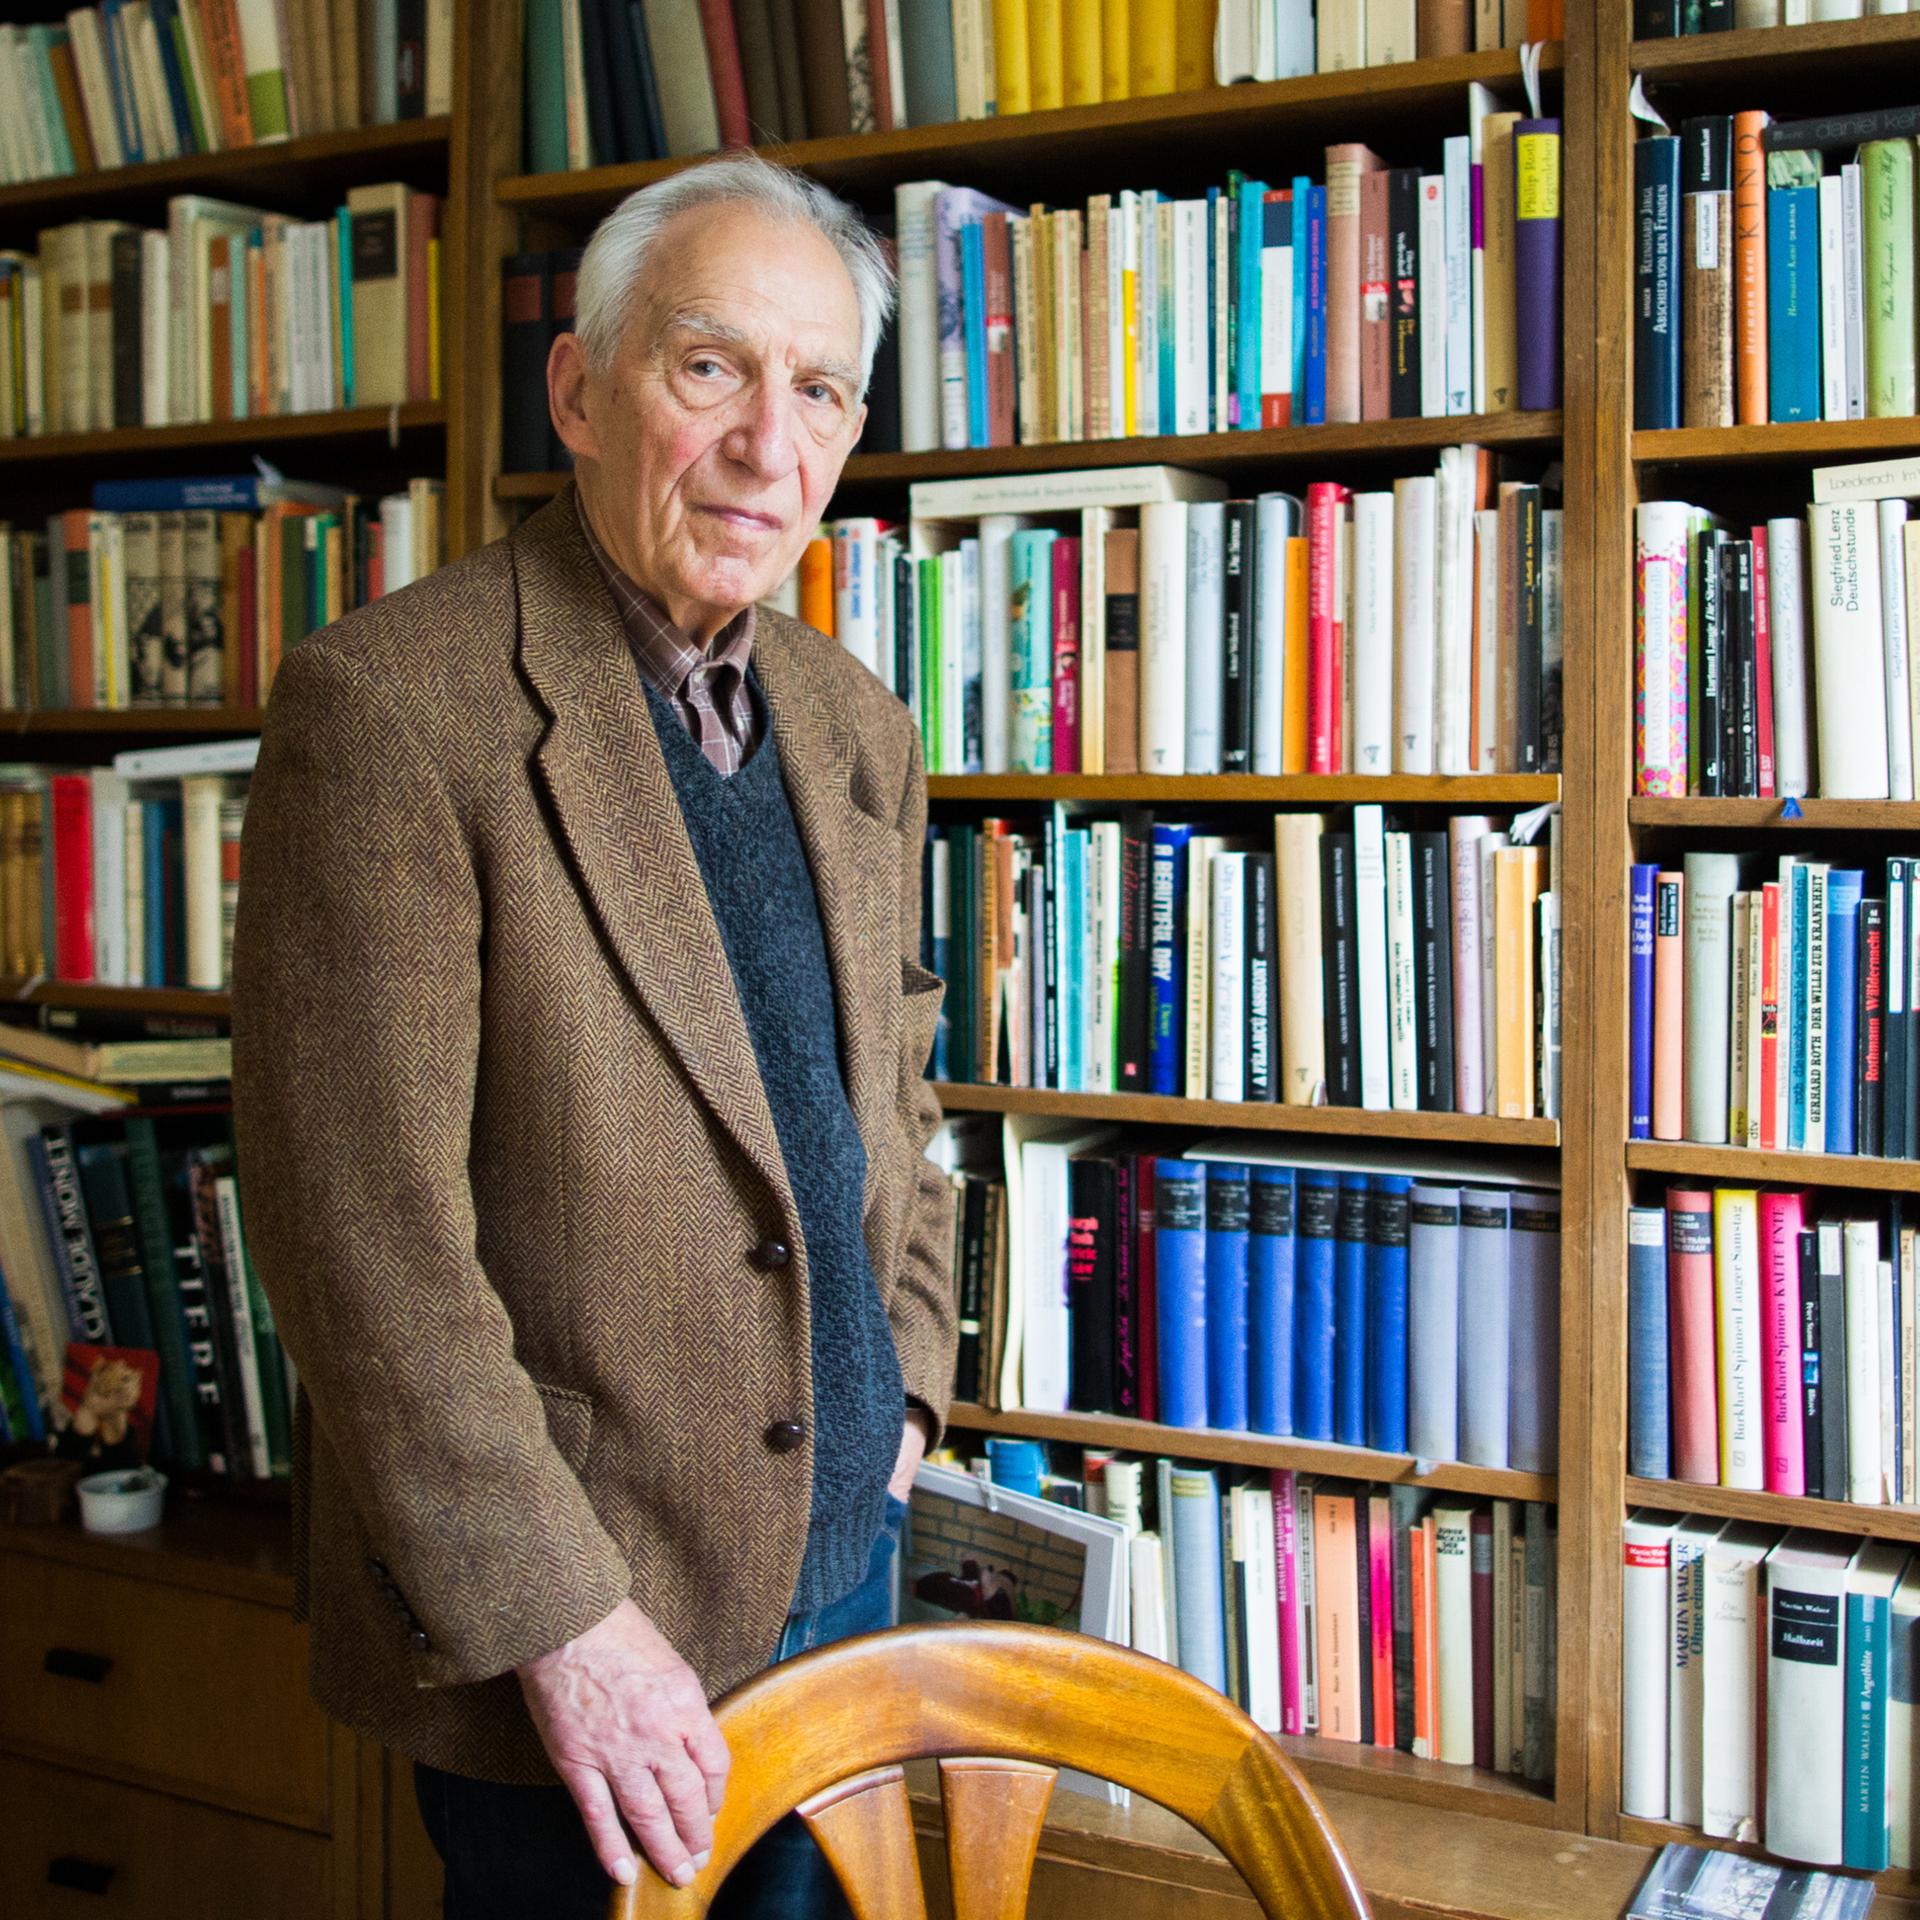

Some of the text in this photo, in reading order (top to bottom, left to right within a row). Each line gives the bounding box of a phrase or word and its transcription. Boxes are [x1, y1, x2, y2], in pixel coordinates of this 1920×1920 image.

[1524, 138, 1539, 213] Philip Roth
[1541, 138, 1557, 213] Gegenleben
[1653, 183, 1668, 334] ABSCHIED VON DEN FEINDEN
[1830, 510, 1845, 607] Siegfried Lenz
[1845, 508, 1859, 612] Deutschstunde
[1152, 844, 1174, 982] A BEAUTIFUL DAY
[1810, 876, 1822, 1124] GERHARD ROTH DER WILLE ZUR KRANKHEIT
[1864, 931, 1880, 1082] Rothmann Wäldernacht
[46, 1138, 106, 1340] CLAUDE MONET
[1731, 1205, 1748, 1440] Burkhard Spinnen Langer Samstag
[1776, 1303, 1789, 1357] Spinnen
[1775, 1360, 1787, 1423] Burkhard
[1676, 1544, 1688, 1669] MARTIN WALSER
[1689, 1614, 1704, 1655] Ohne
[1860, 1650, 1875, 1698] Angstblüte
[1861, 1714, 1870, 1760] WALSER
[1860, 1765, 1870, 1813] MARTIN
